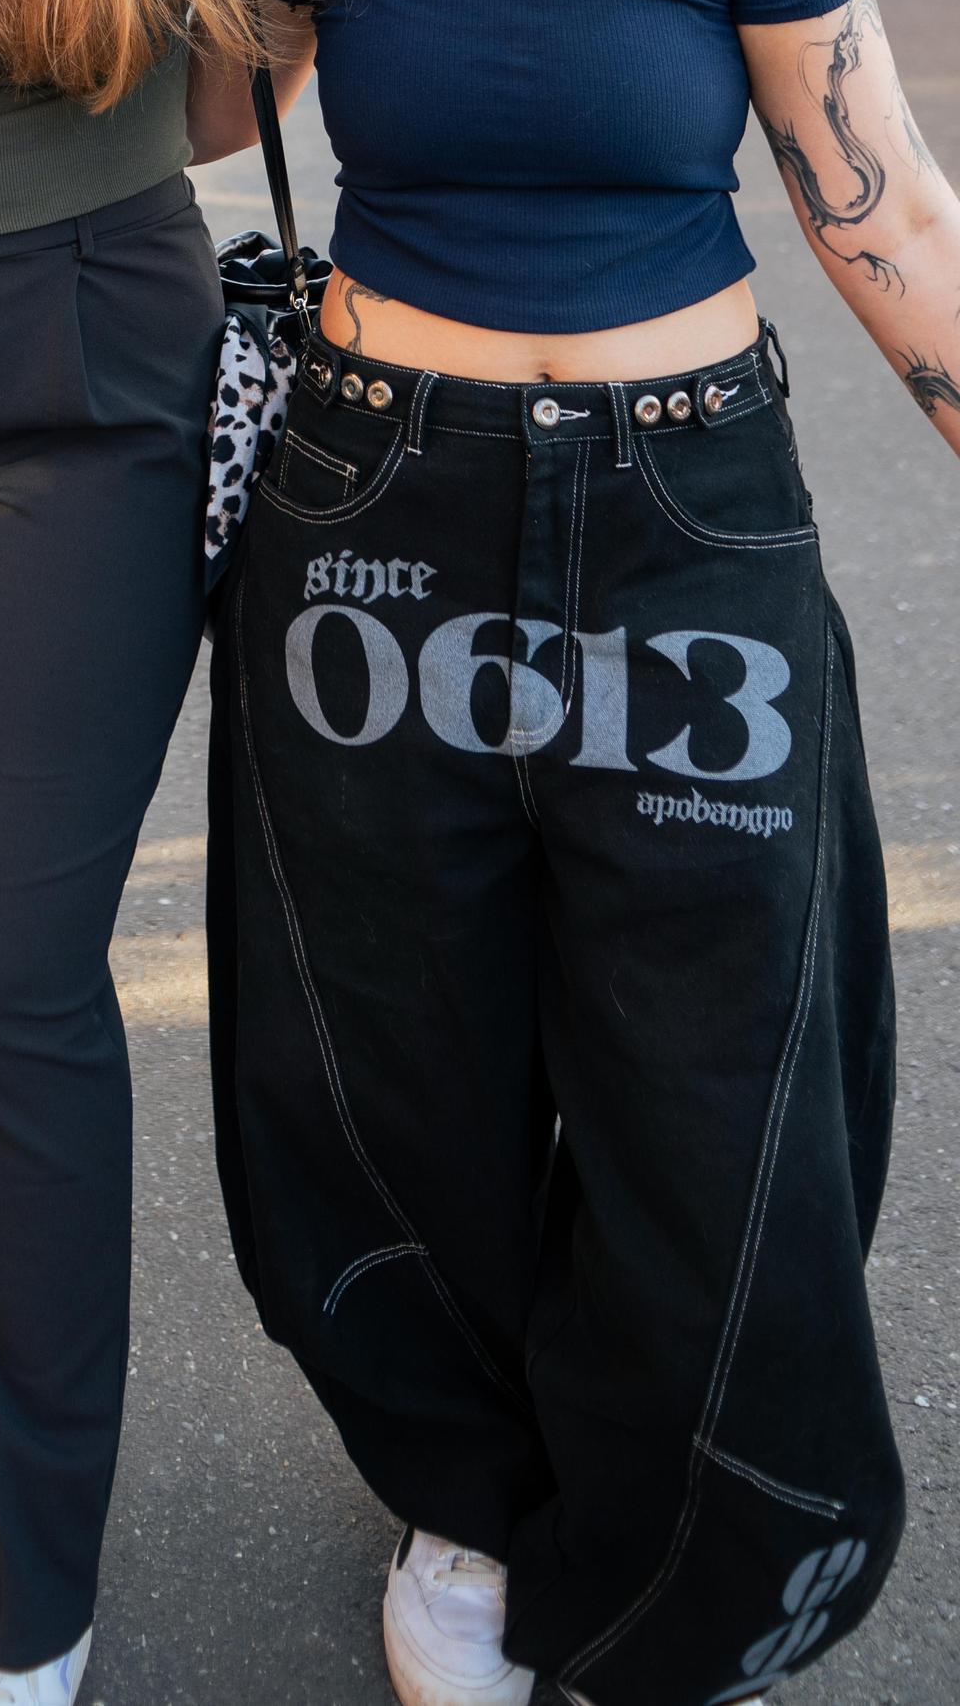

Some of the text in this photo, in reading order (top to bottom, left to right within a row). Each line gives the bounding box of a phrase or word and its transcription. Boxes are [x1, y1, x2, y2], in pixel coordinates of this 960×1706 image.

[303, 549, 438, 604] since
[285, 604, 793, 781] 0613
[637, 786, 793, 839] apobangpo
